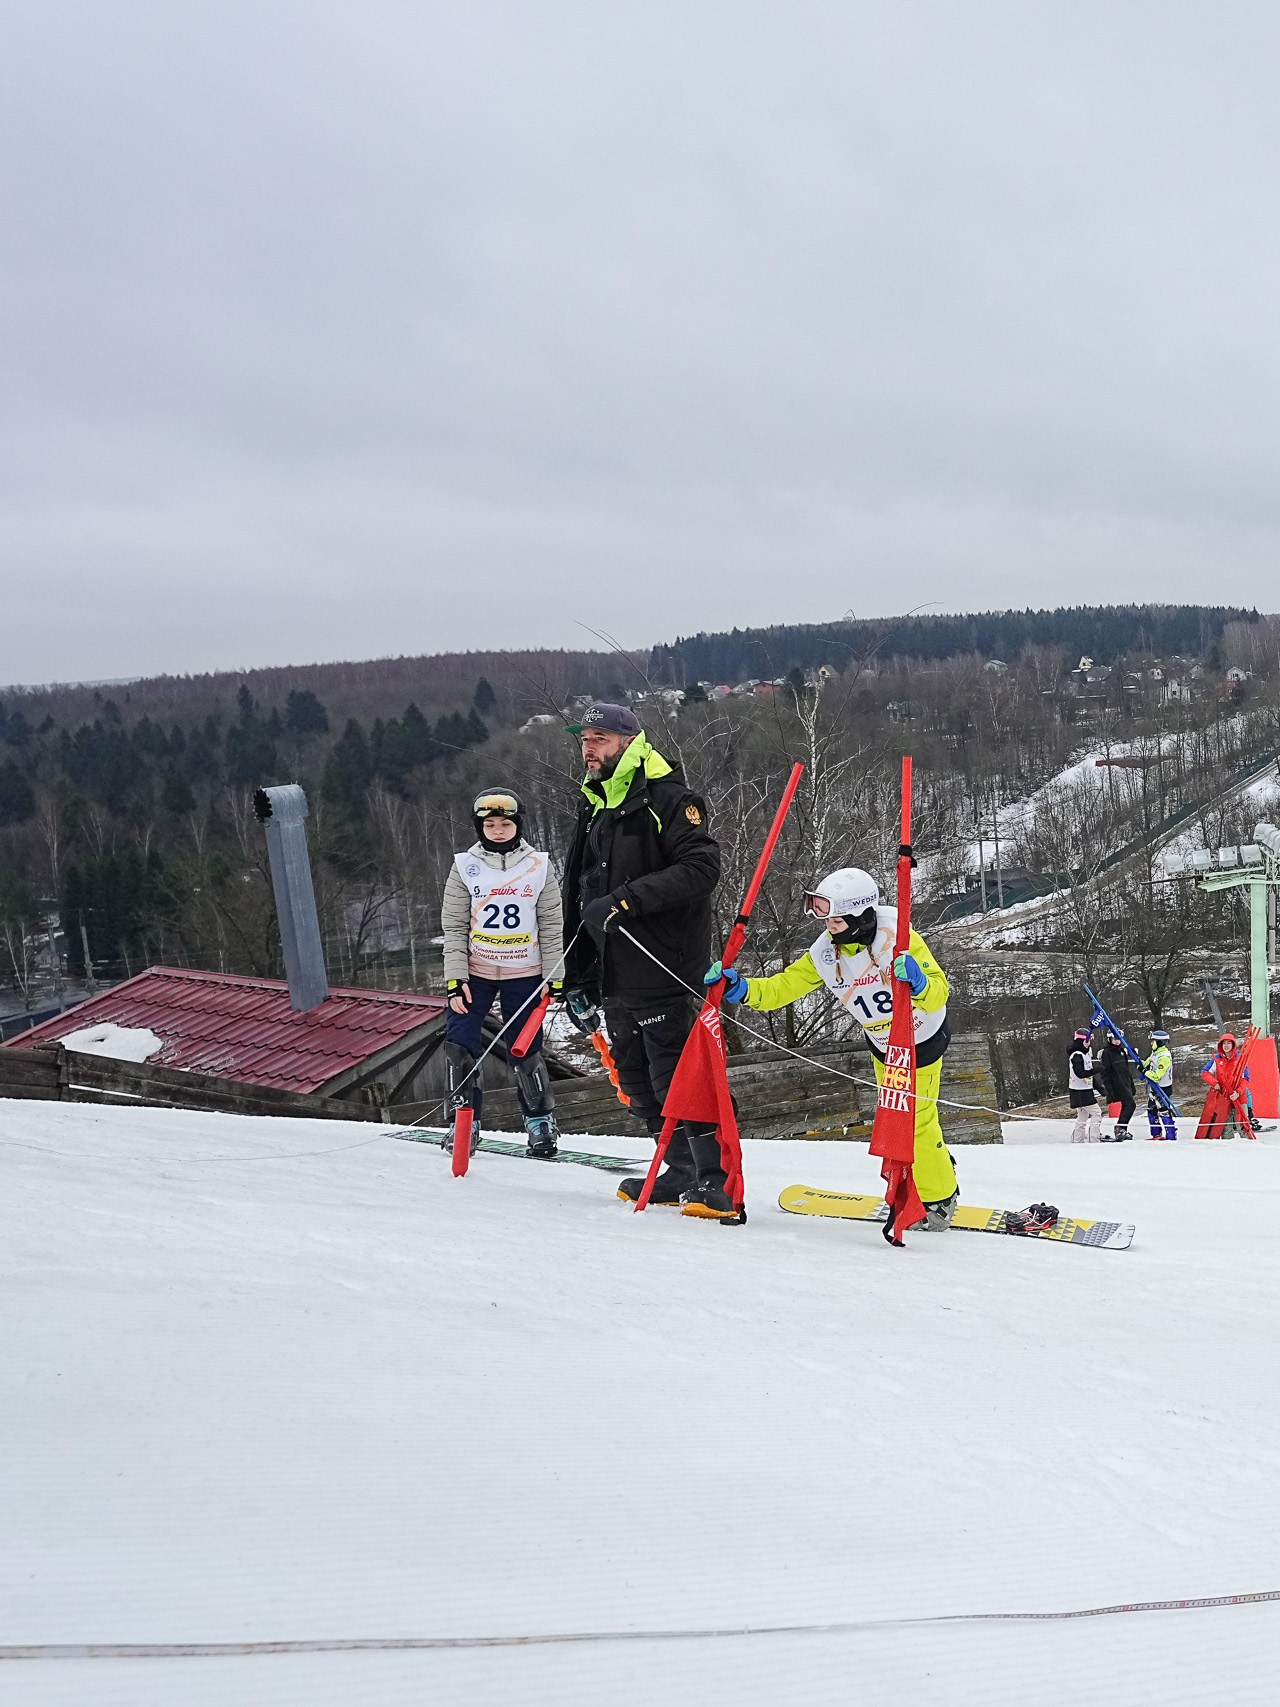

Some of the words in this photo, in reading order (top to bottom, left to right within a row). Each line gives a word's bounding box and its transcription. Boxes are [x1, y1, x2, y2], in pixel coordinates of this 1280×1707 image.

[482, 903, 521, 930] 28
[472, 934, 523, 945] FISCHER
[853, 990, 893, 1019] 18
[803, 1190, 864, 1202] NOBILE
